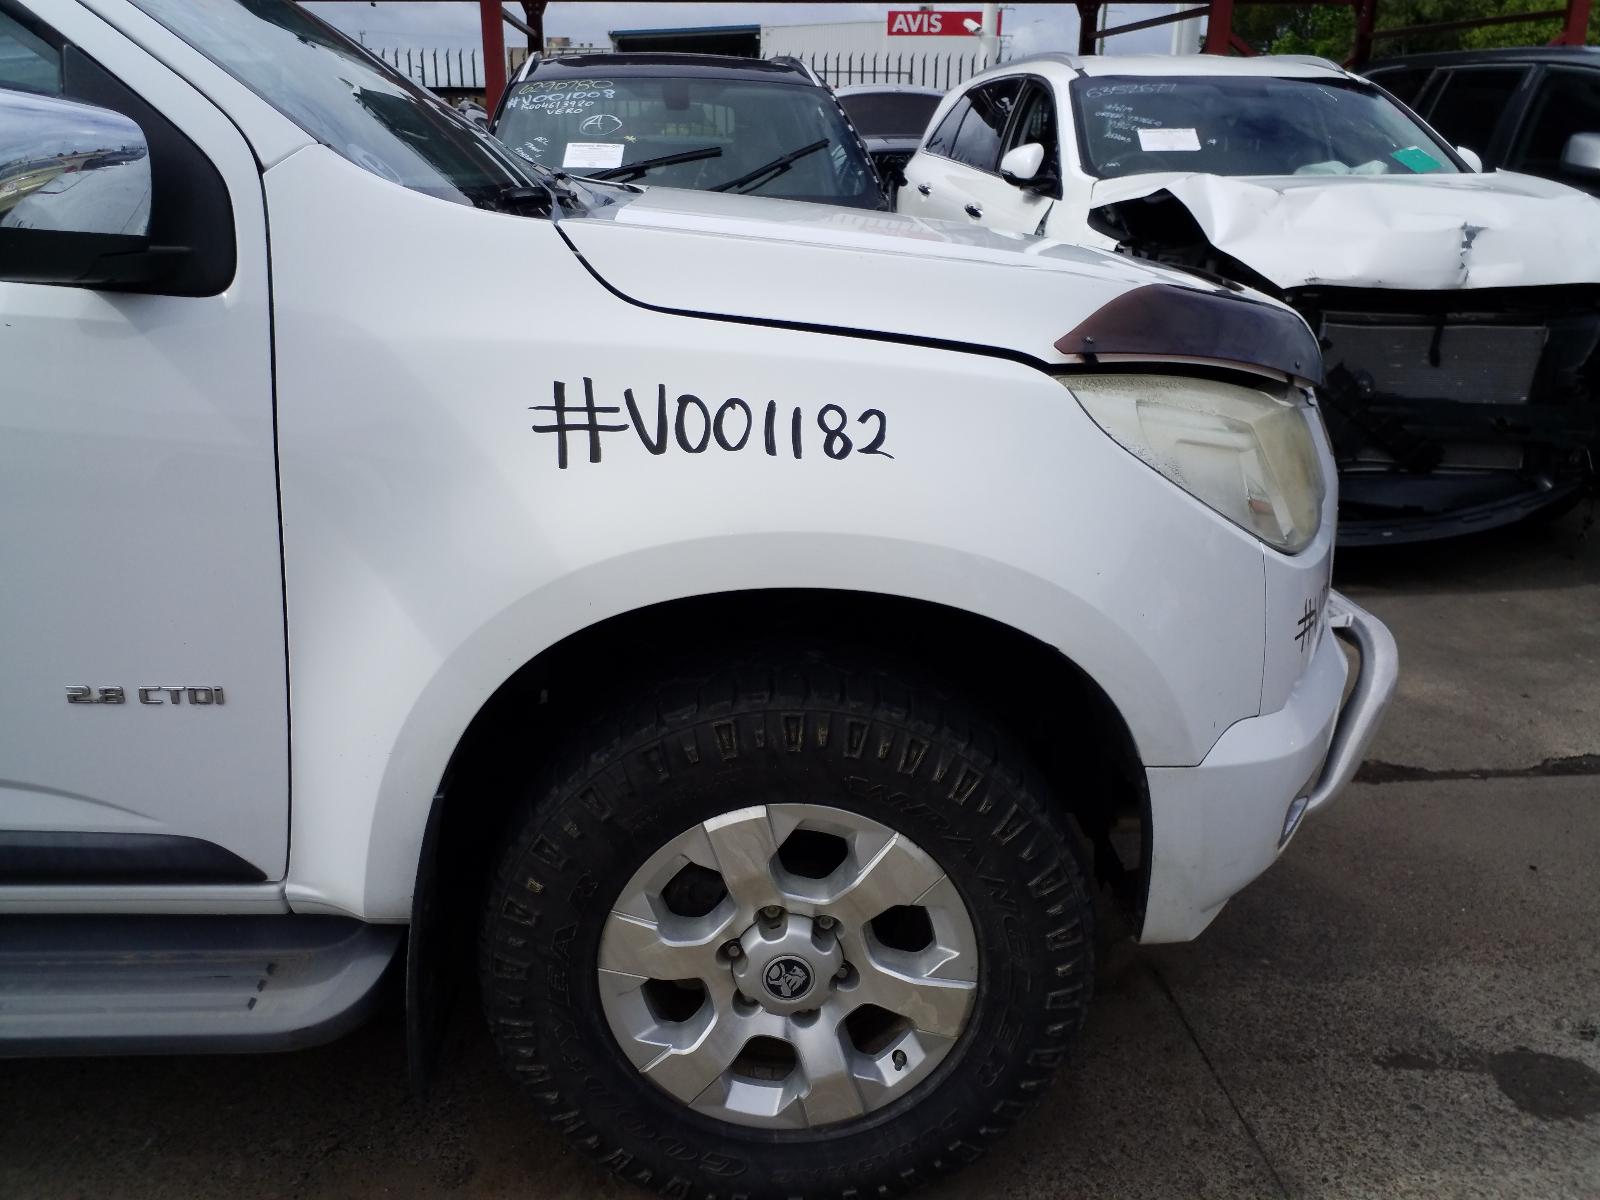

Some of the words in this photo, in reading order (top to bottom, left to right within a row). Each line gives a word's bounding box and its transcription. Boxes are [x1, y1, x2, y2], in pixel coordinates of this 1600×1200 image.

[892, 13, 943, 33] AVIS
[528, 377, 895, 469] #V001182
[65, 685, 126, 705] 2.8
